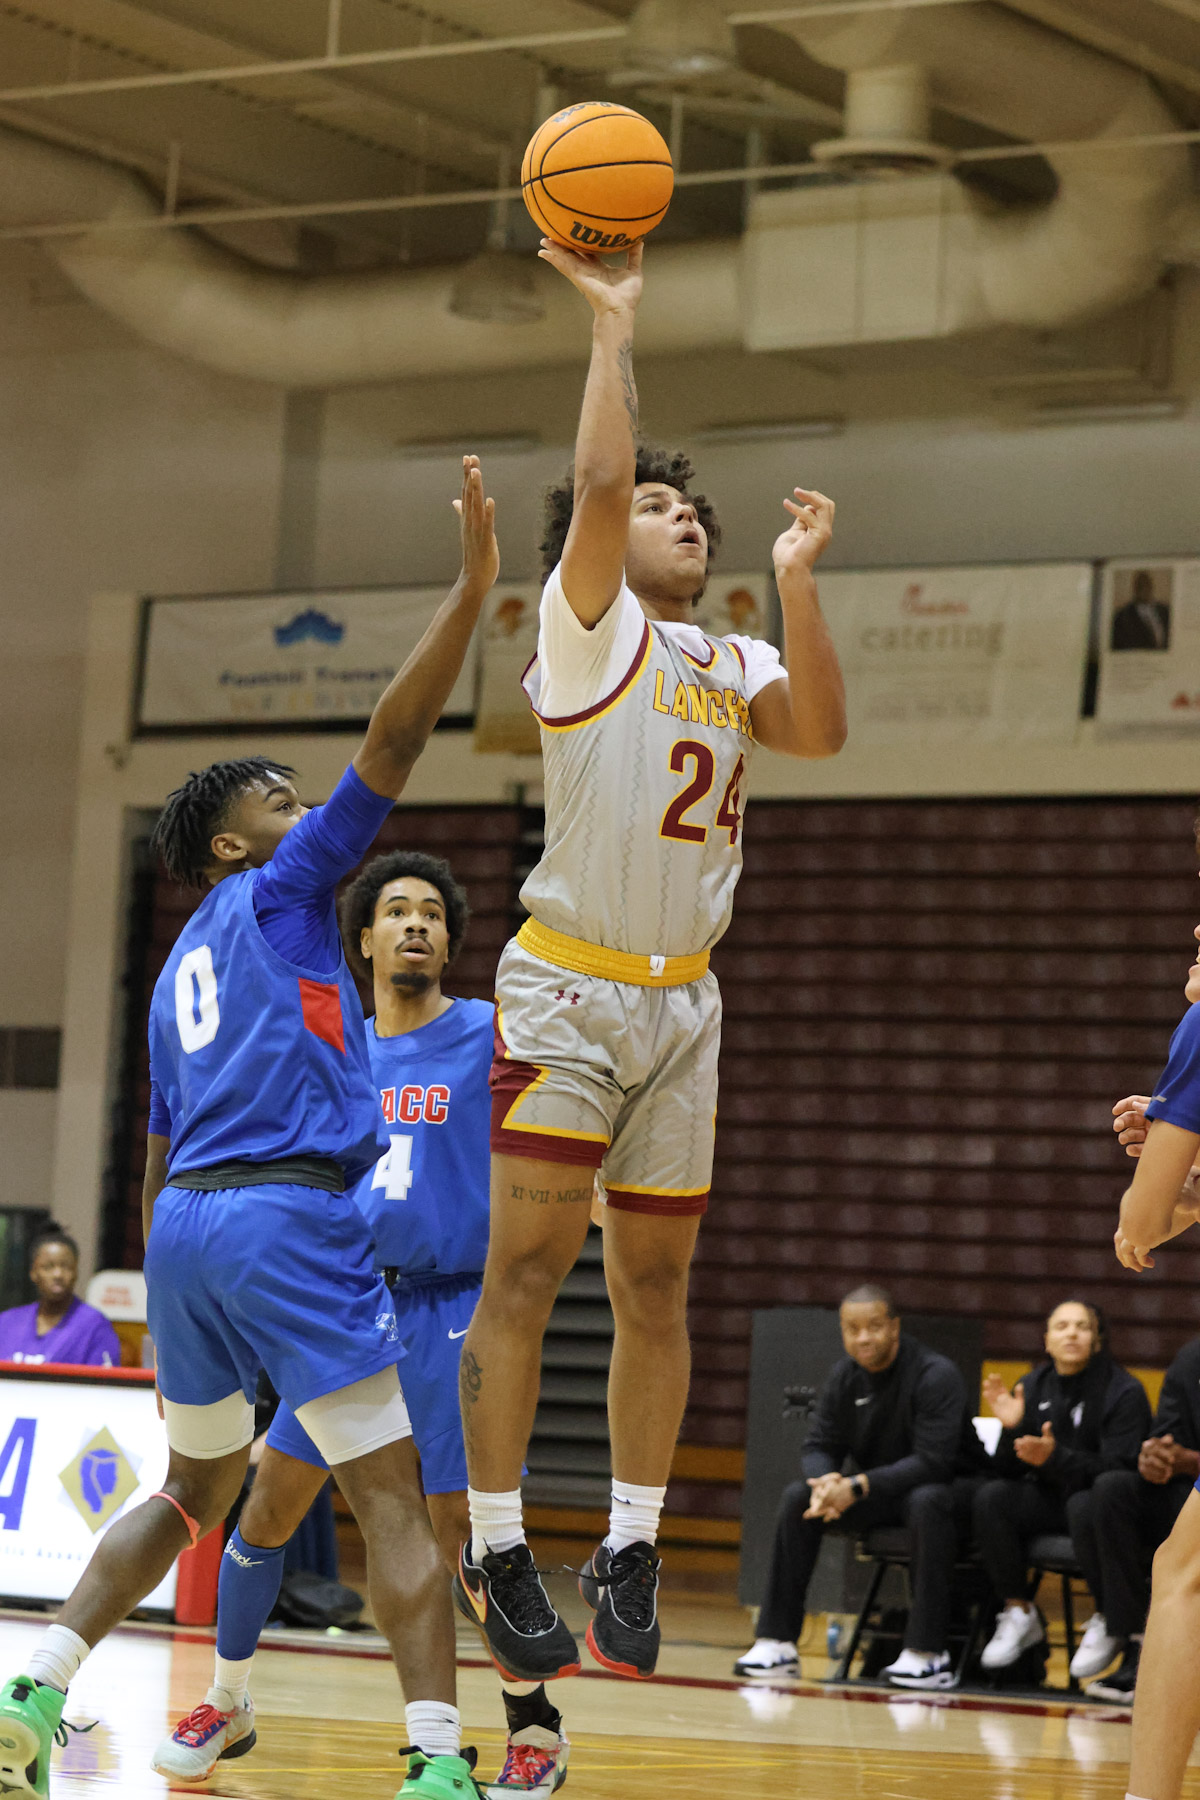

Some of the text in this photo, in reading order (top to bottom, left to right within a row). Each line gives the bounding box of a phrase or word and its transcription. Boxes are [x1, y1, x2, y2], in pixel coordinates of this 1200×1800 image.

[653, 669, 753, 740] LANCER
[658, 738, 744, 848] 24
[174, 944, 221, 1055] 0
[0, 1416, 38, 1531] A
